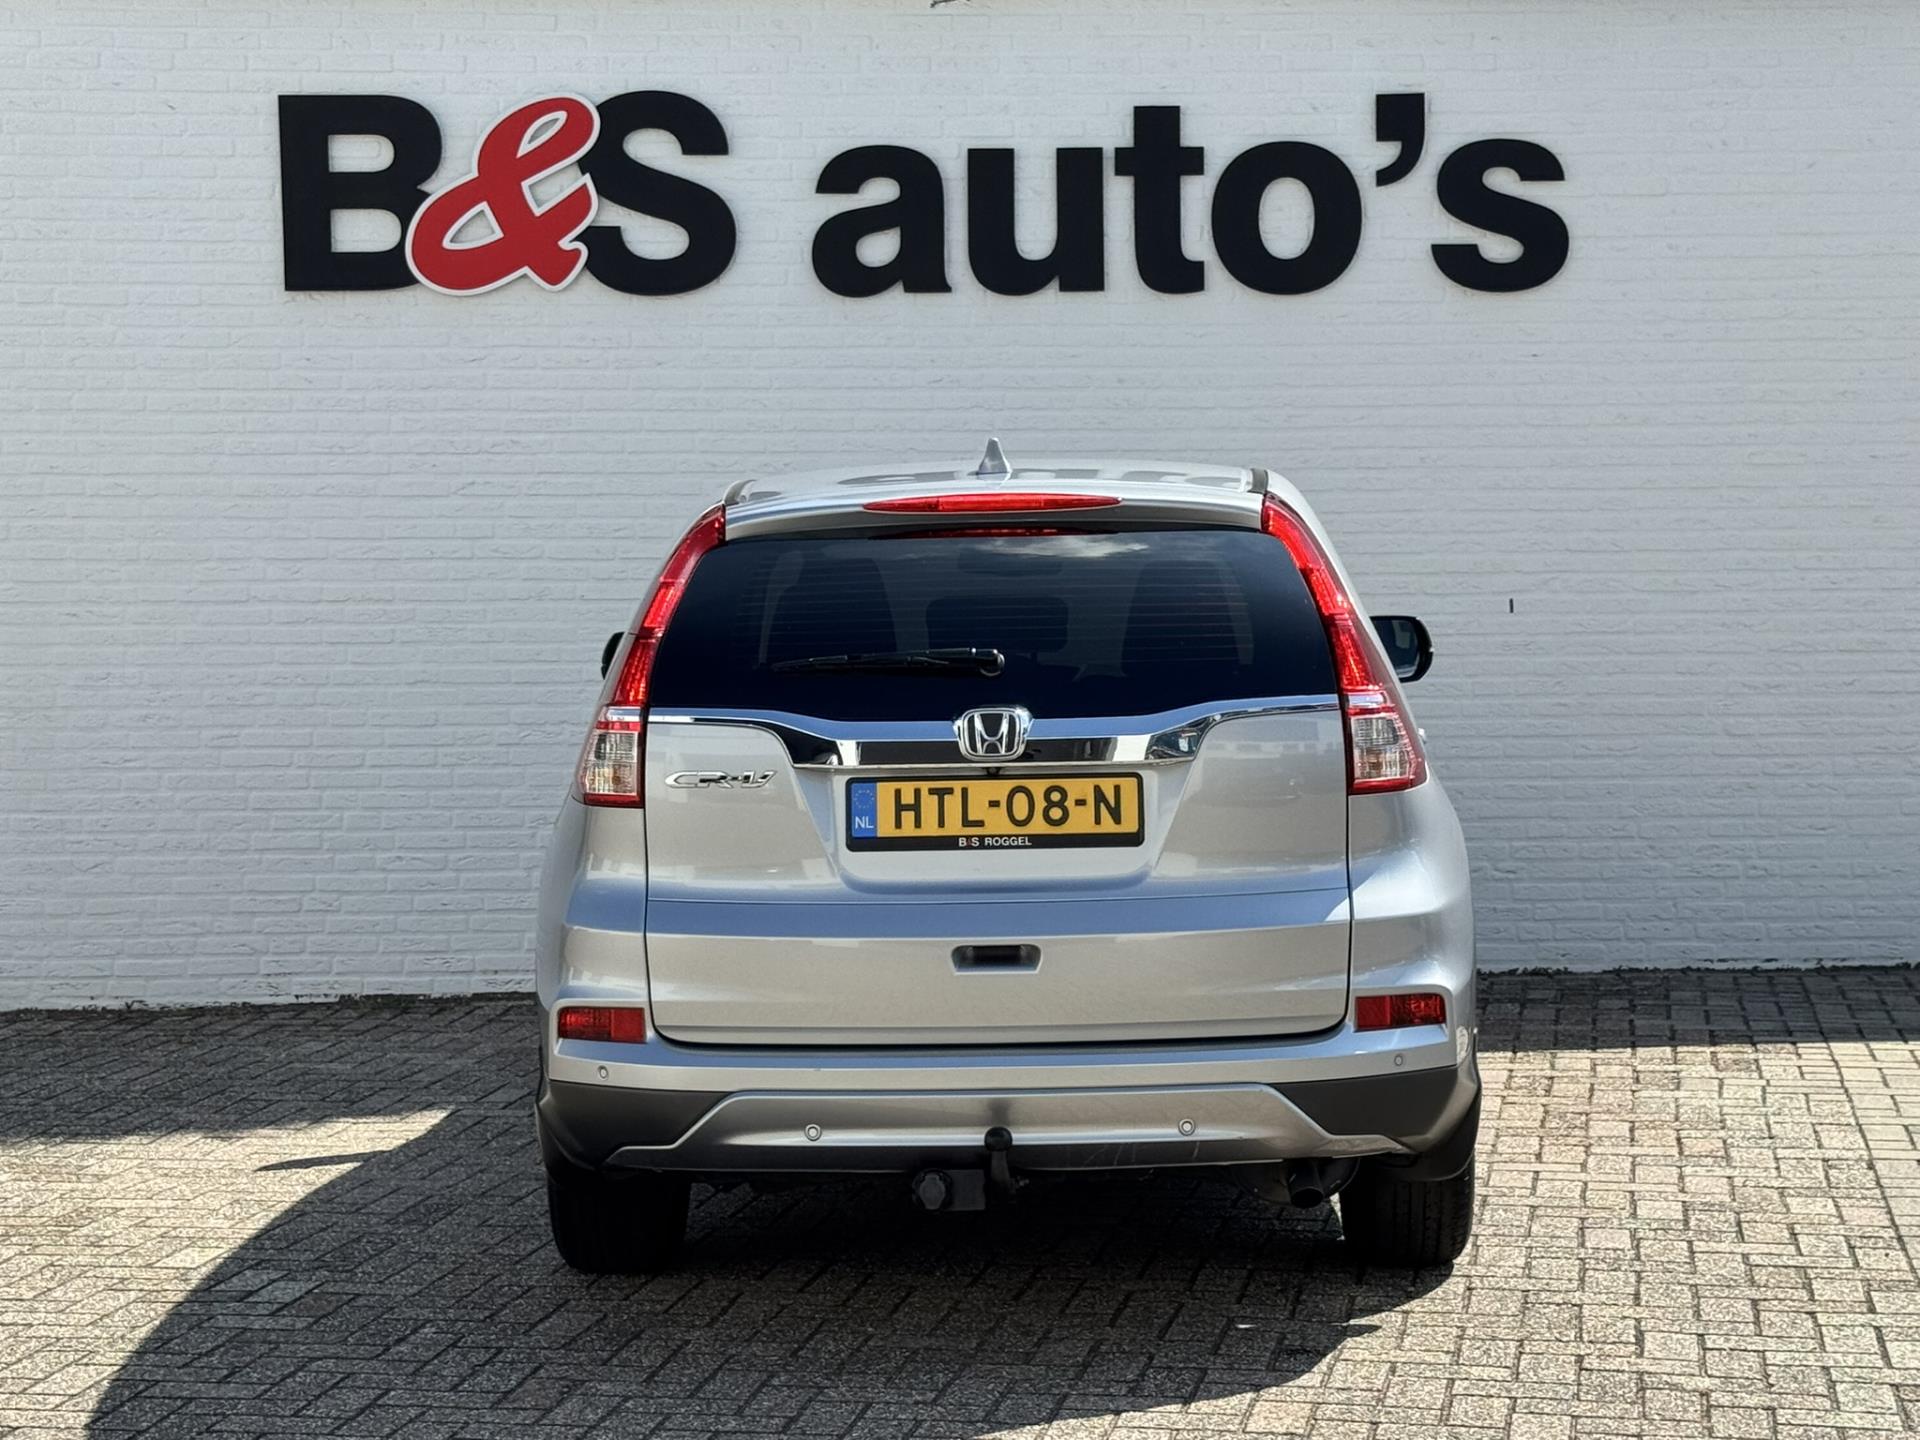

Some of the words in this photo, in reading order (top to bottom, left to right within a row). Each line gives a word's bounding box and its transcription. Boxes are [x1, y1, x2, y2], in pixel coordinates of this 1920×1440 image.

[278, 90, 737, 296] B&S
[811, 92, 1570, 297] auto's
[664, 770, 777, 788] CR-V
[894, 784, 1122, 829] HTL-08-N
[855, 816, 875, 829] NL
[984, 836, 1032, 846] ROGGEL
